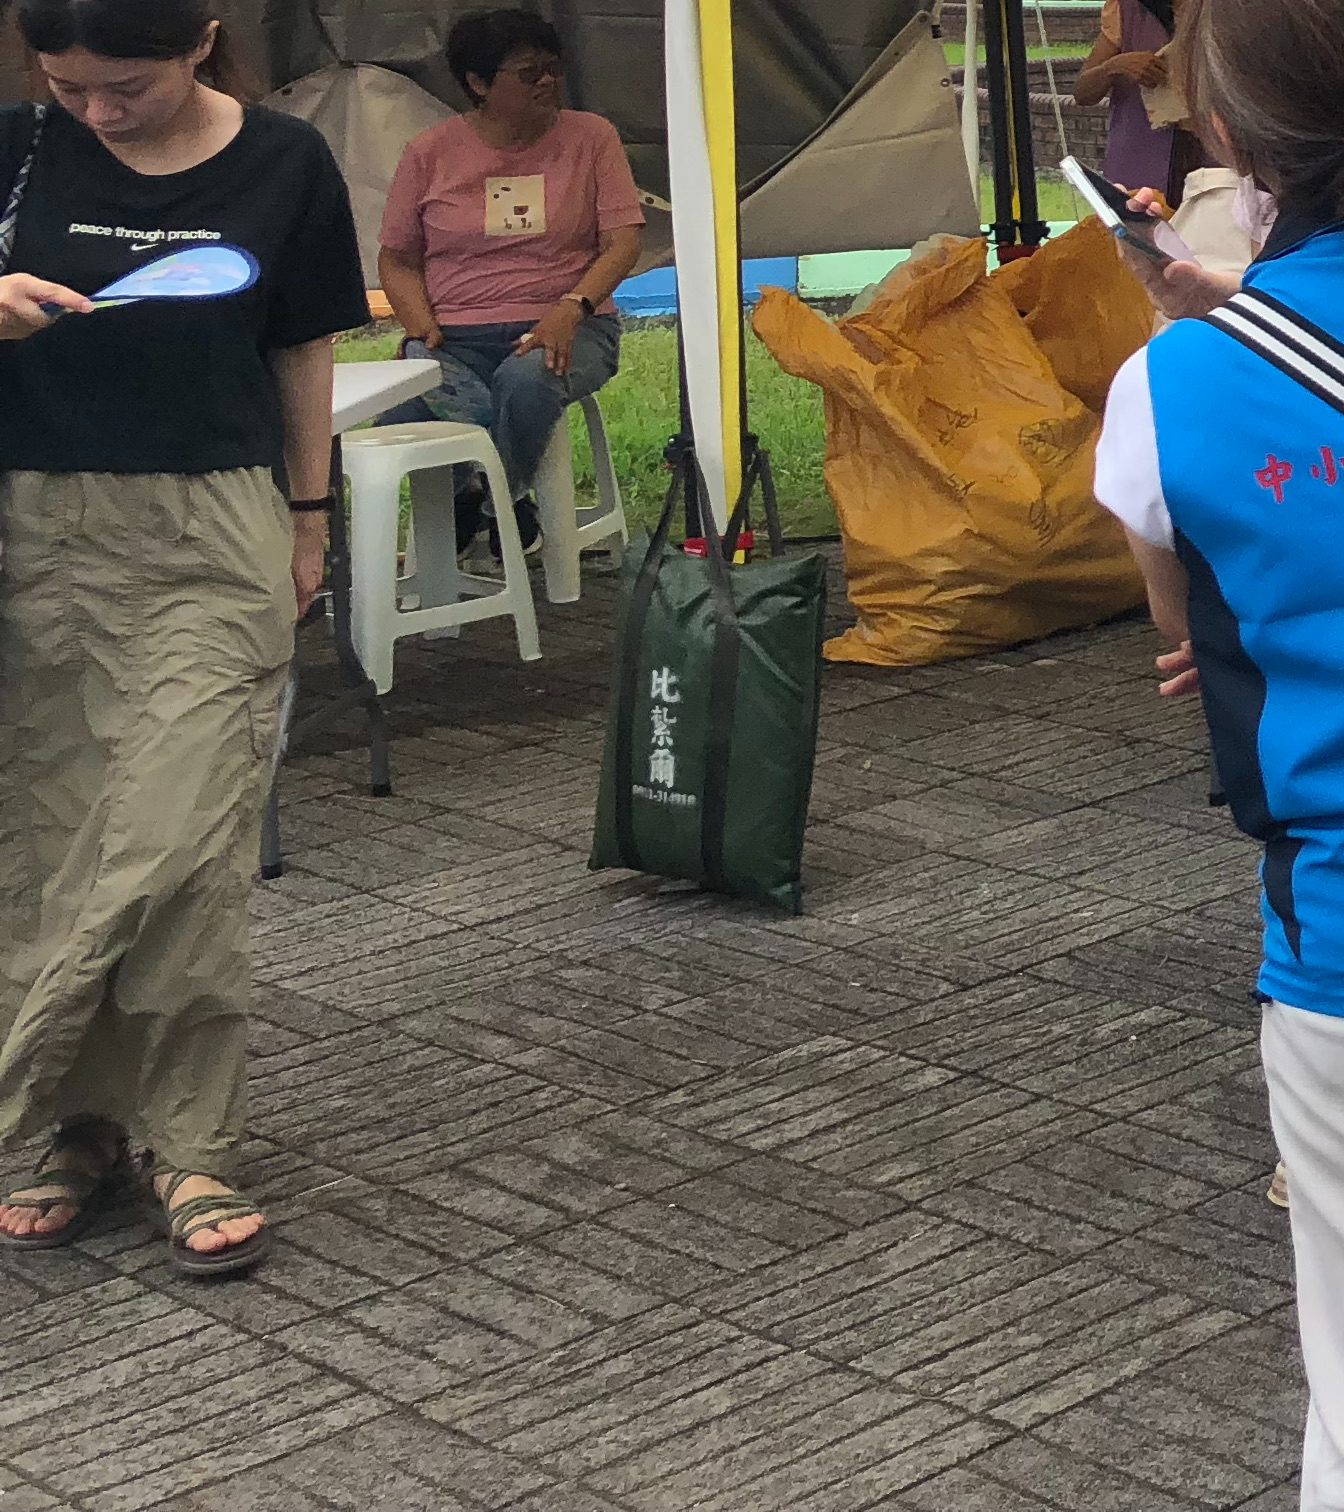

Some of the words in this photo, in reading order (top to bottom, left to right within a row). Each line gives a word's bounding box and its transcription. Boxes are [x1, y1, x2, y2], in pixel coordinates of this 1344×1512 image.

[69, 222, 113, 236] peace
[115, 226, 165, 242] through
[167, 229, 222, 241] practice
